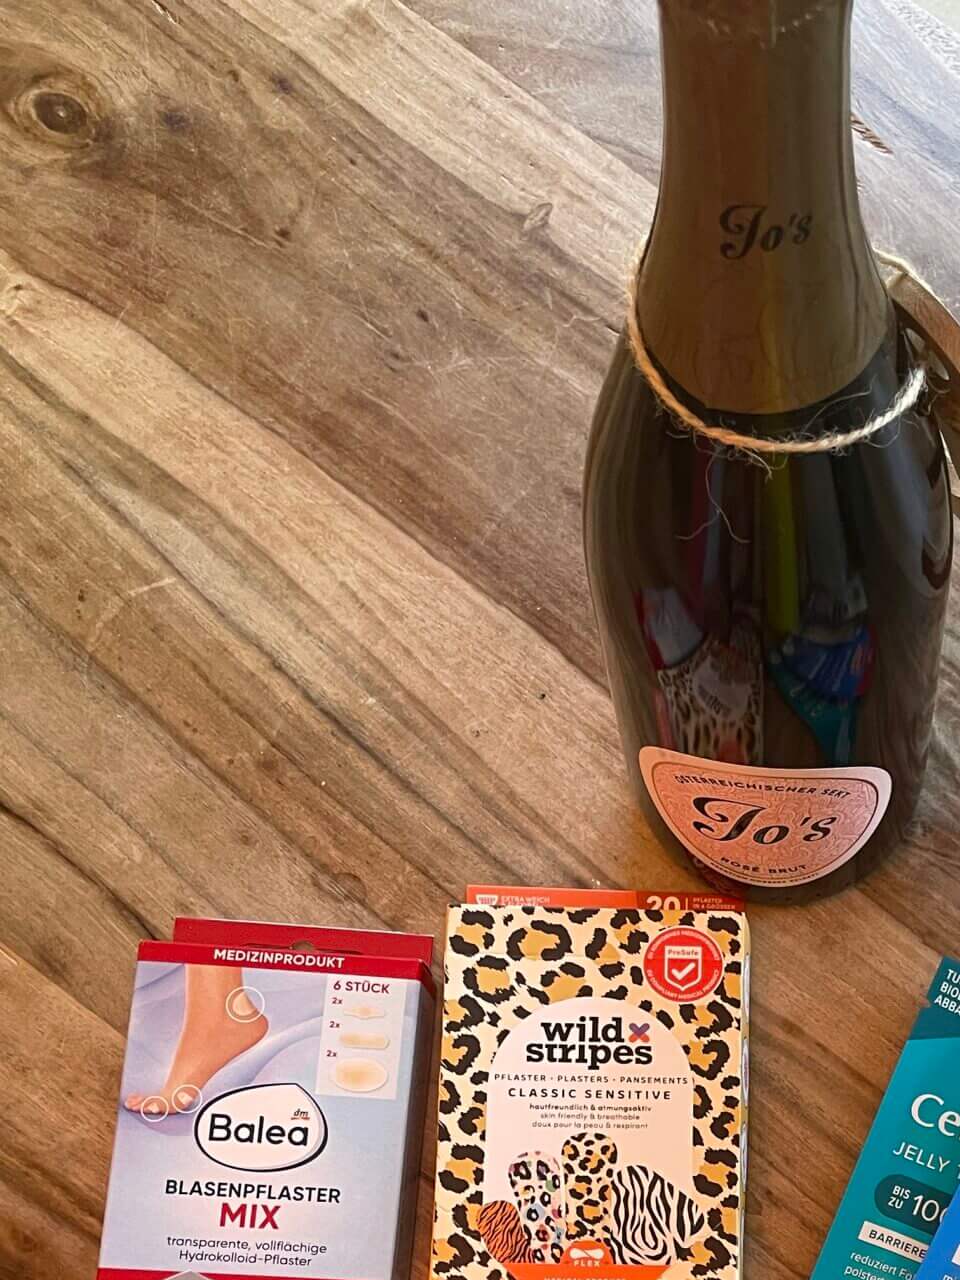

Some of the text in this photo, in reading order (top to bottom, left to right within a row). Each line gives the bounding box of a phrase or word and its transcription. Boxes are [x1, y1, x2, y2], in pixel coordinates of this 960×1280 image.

[719, 204, 812, 260] Jo's
[674, 775, 851, 798] ÖSTERREICHISCHER SEKT
[692, 797, 837, 845] Jo's
[720, 856, 760, 873] ROSÉ
[768, 864, 807, 874] BRUT
[213, 949, 345, 968] MEDIZINPRODUKT
[333, 980, 390, 995] 6 STÜCK
[331, 997, 343, 1005] 2x
[329, 1021, 340, 1029] 2x
[541, 1016, 624, 1043] wild
[326, 1049, 337, 1058] 2x
[526, 1043, 652, 1070] stripes
[557, 1075, 609, 1083] PLASTERS
[620, 1076, 688, 1084] PANSEMENTS
[508, 1088, 671, 1100] CLASSIC SENSITIVE
[208, 1114, 309, 1147] Balea
[892, 1141, 950, 1173] JELLY
[165, 1179, 340, 1204] BLASENPFLASTER
[892, 1185, 911, 1200] BIS
[887, 1197, 904, 1209] ZU
[219, 1202, 280, 1230] MIX
[167, 1236, 327, 1256] transparente, vollflächige
[868, 1229, 928, 1259] BARRIERE
[178, 1249, 312, 1268] Hydrokolloid-Pflaster
[850, 1252, 897, 1275] reduziert
